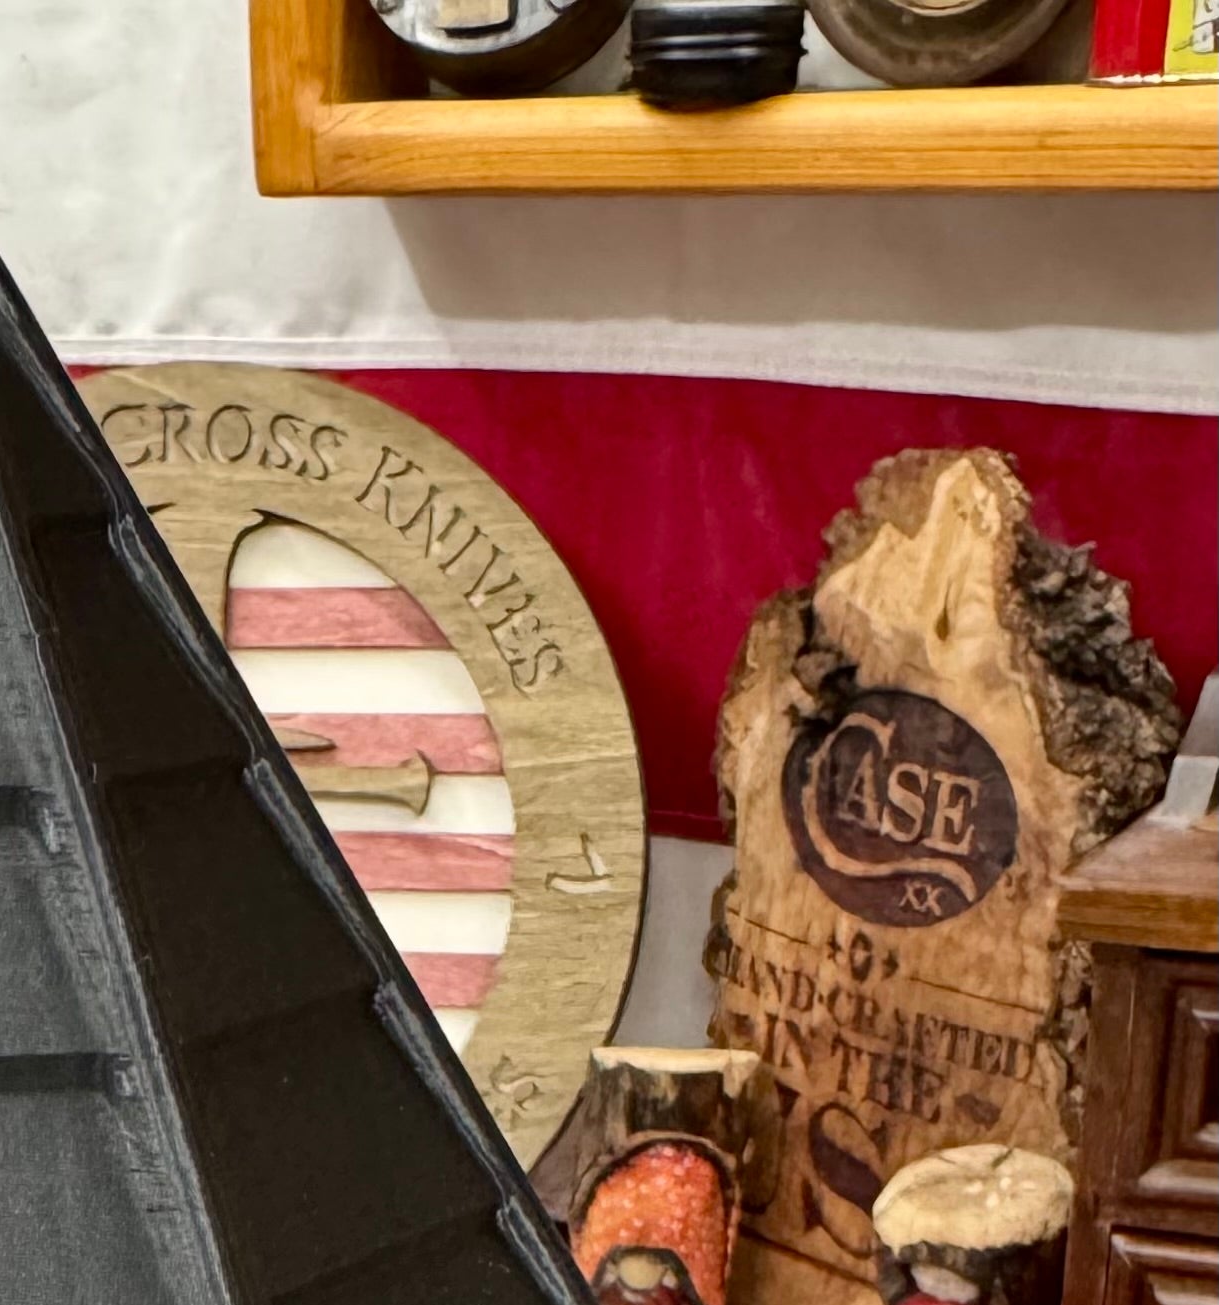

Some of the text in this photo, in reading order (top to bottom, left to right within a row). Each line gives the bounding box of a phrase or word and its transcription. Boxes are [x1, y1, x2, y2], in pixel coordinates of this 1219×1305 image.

[102, 402, 565, 698] CROSS KNIVES
[802, 711, 979, 903] CASE
[898, 878, 945, 917] XX
[763, 1012, 945, 1126] IN THE
